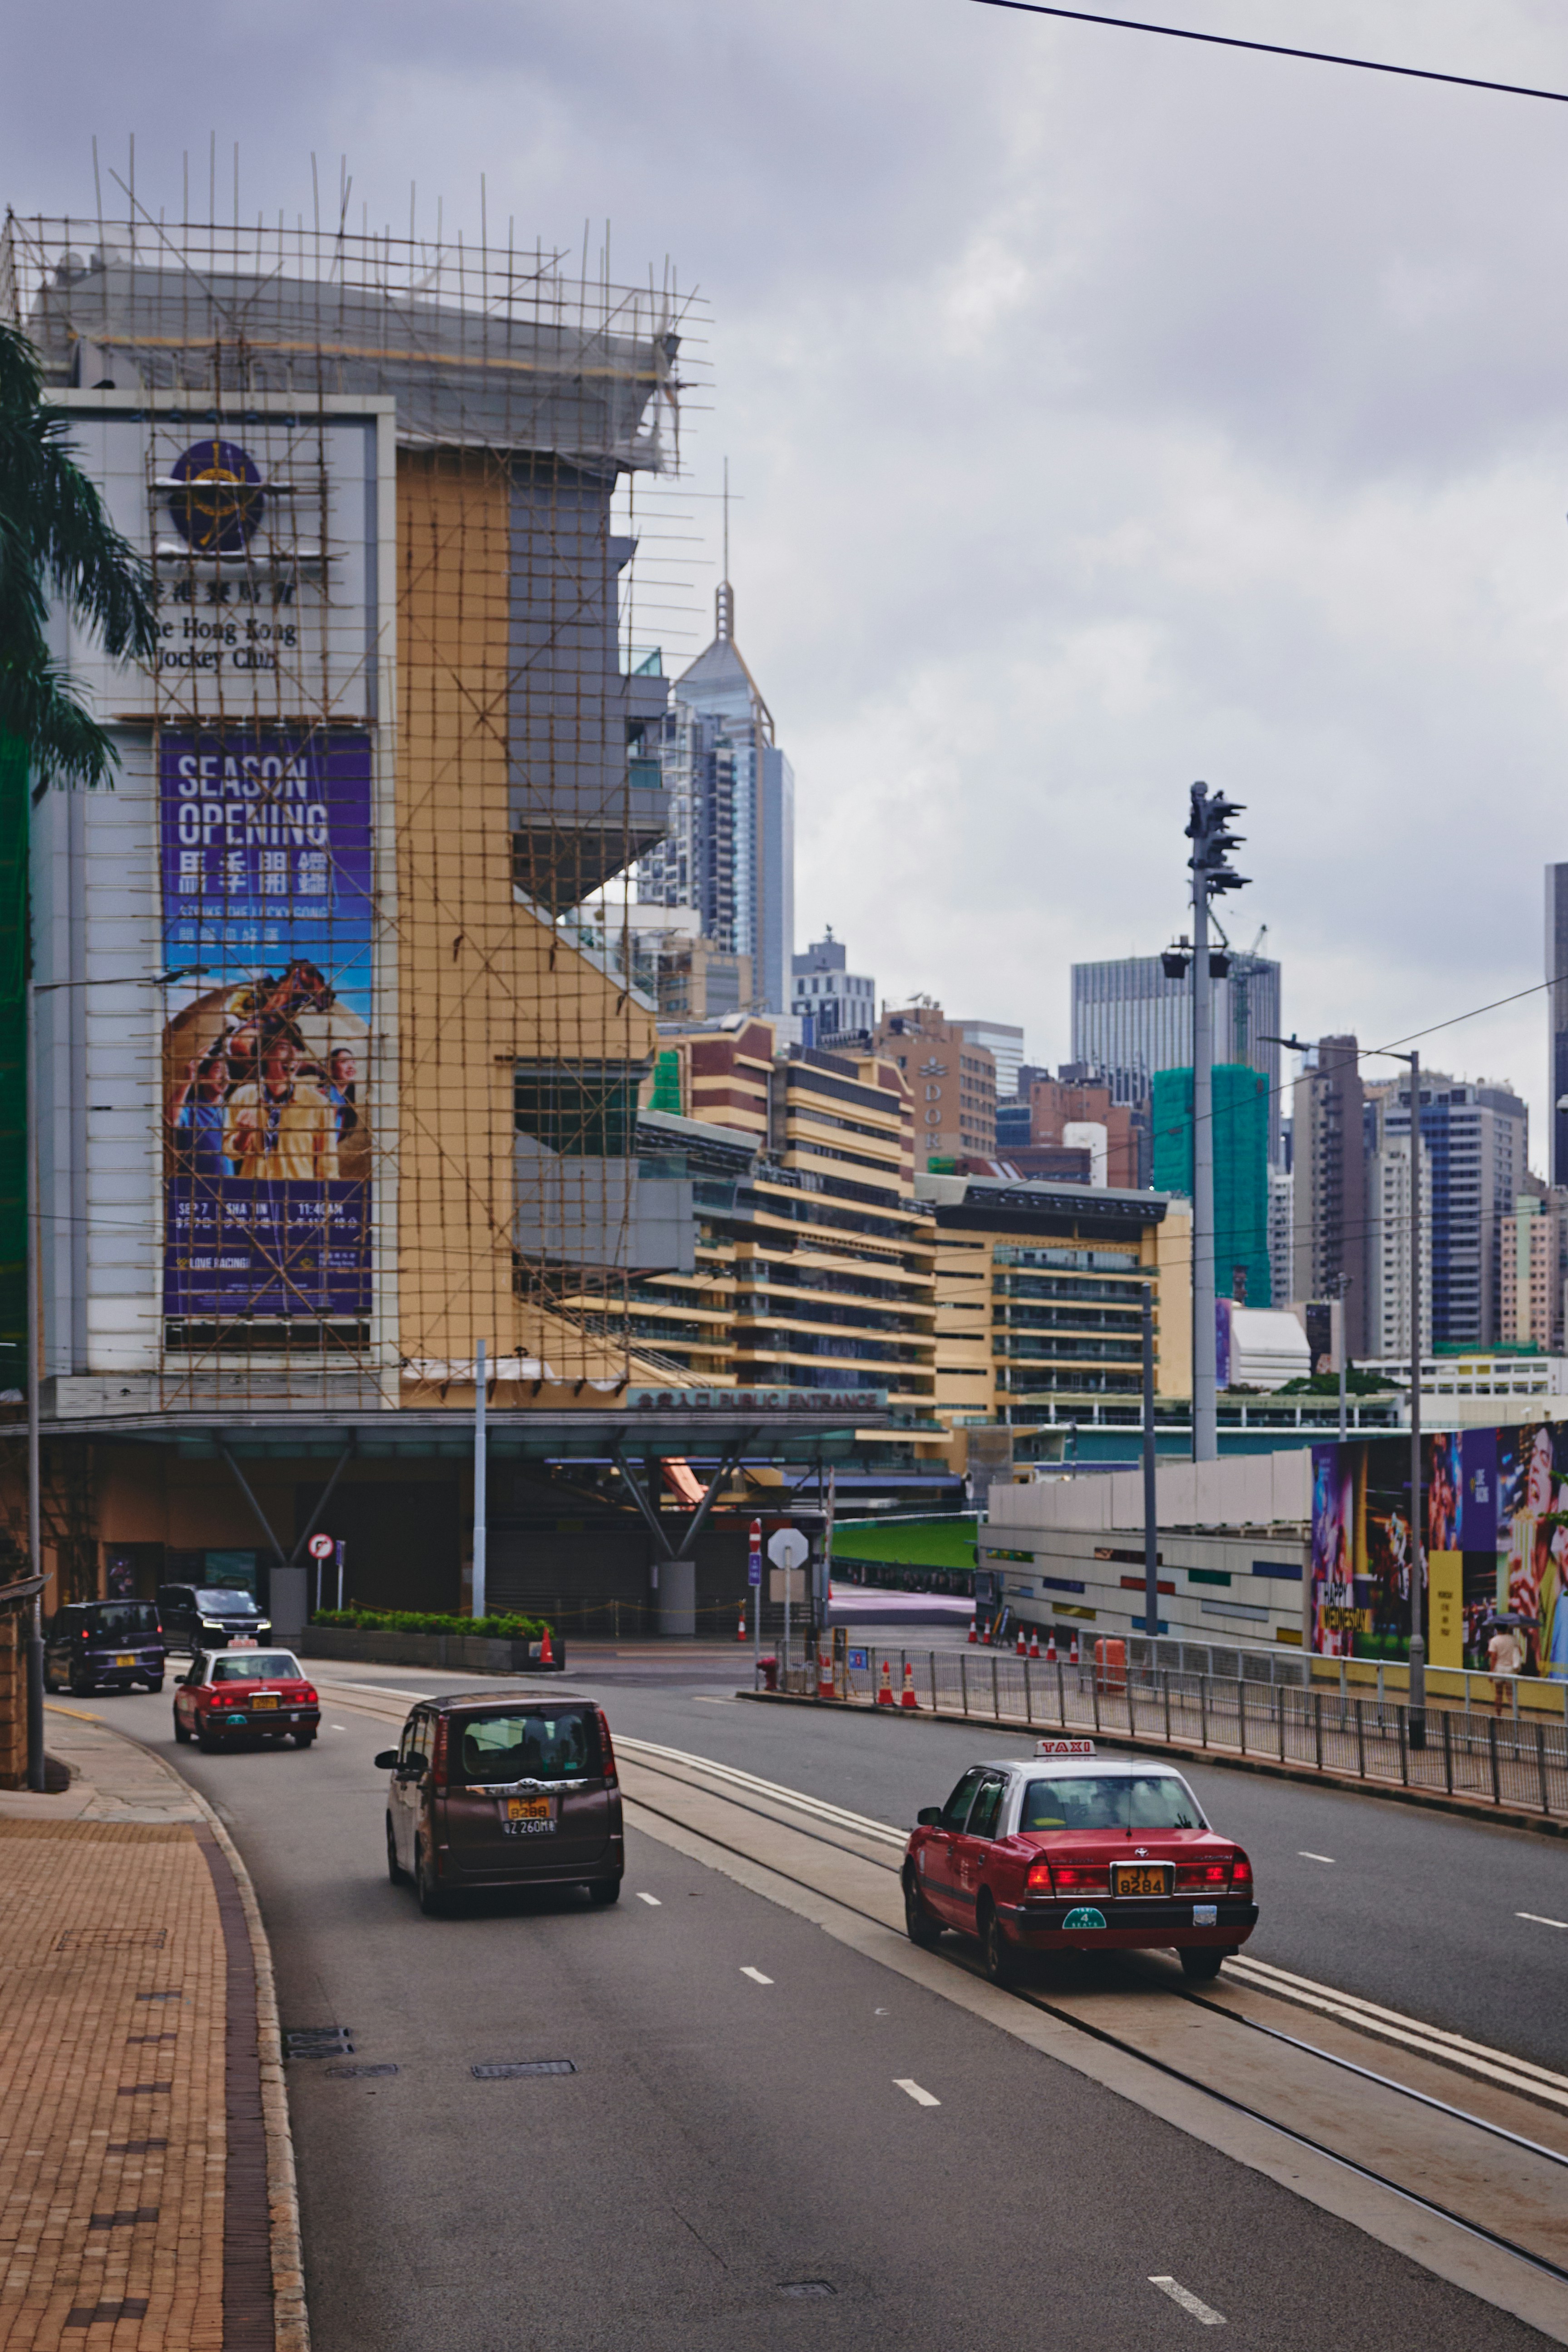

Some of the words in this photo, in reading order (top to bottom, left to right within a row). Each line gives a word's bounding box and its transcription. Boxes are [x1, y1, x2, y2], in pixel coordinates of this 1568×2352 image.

[183, 617, 237, 646] Hong
[246, 618, 297, 647] Kong
[157, 645, 224, 674] Jockey
[232, 647, 276, 669] Club
[178, 755, 307, 798] SEASON
[178, 802, 328, 845] OPENING
[179, 850, 327, 894] 馬季開鑼
[178, 1202, 199, 1215] SEP
[202, 1203, 208, 1215] 7
[226, 1203, 247, 1215] SHA
[250, 1203, 268, 1215] IN
[189, 1257, 213, 1269] LOVE
[719, 1392, 780, 1408] PUBLIC
[788, 1393, 878, 1408] ENTRANCE
[1324, 1582, 1347, 1607] HAPPY
[1324, 1605, 1366, 1633] WEDNESDAY
[1042, 1741, 1090, 1753] TAXI
[1130, 1866, 1151, 1881] JY
[1120, 1880, 1162, 1893] 8284
[1080, 1913, 1088, 1922] 4
